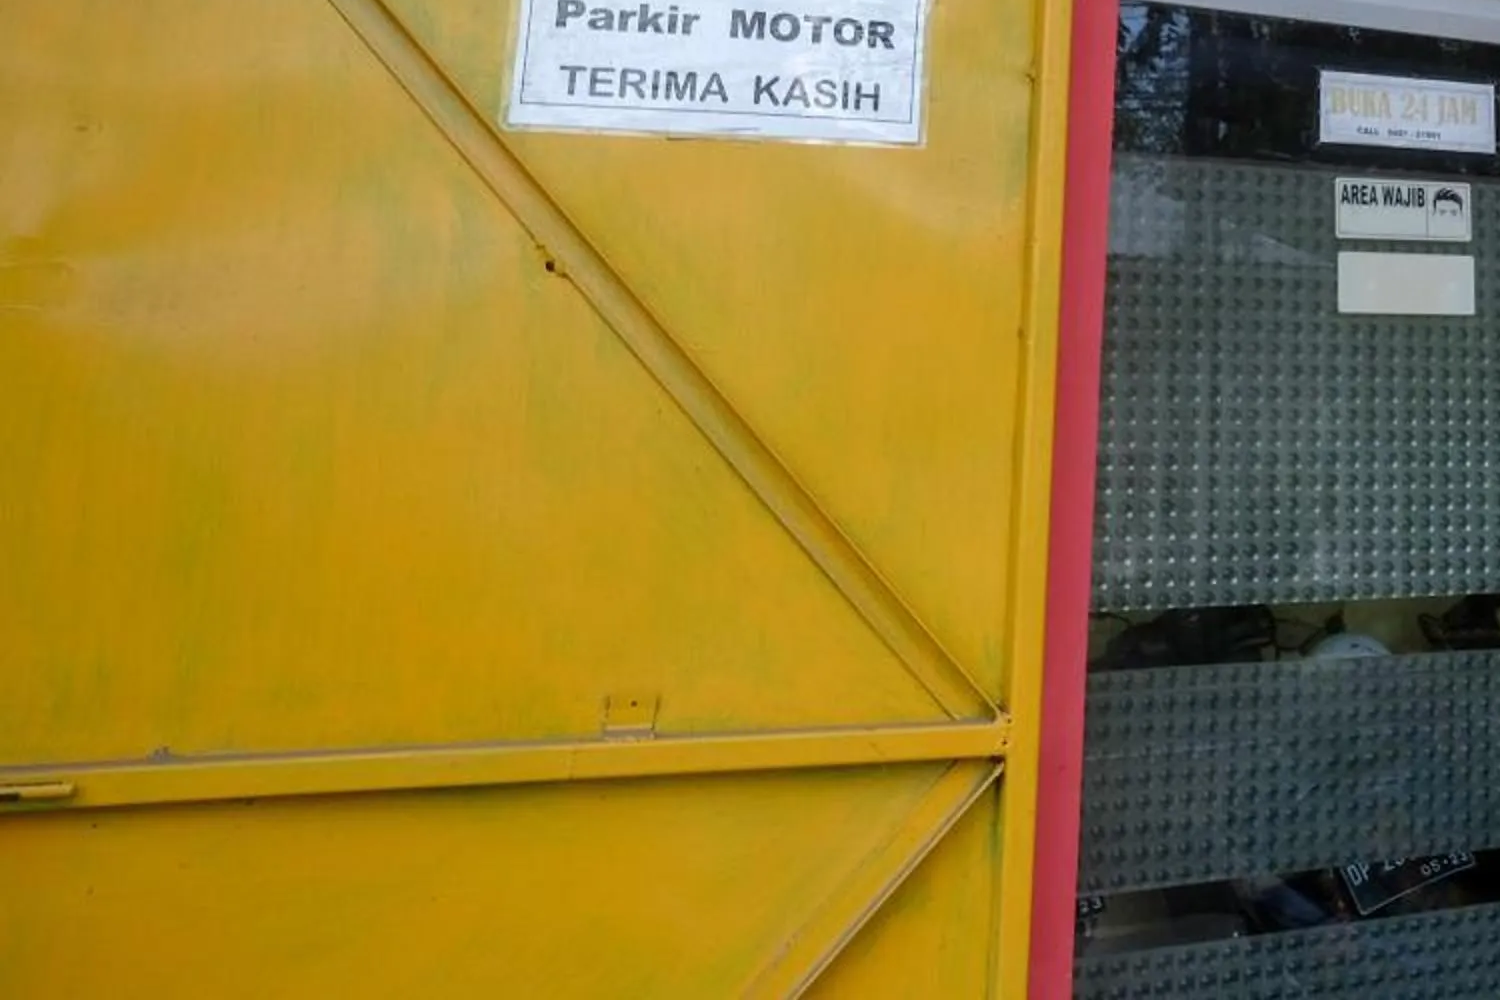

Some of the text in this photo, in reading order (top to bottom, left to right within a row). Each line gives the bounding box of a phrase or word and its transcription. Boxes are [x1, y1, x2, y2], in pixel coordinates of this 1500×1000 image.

[729, 9, 896, 50] MOTOR
[559, 65, 881, 111] TERIMA KASIH
[1330, 85, 1477, 125] BUKA 24 JAM
[1341, 184, 1425, 208] AREA WAJIB
